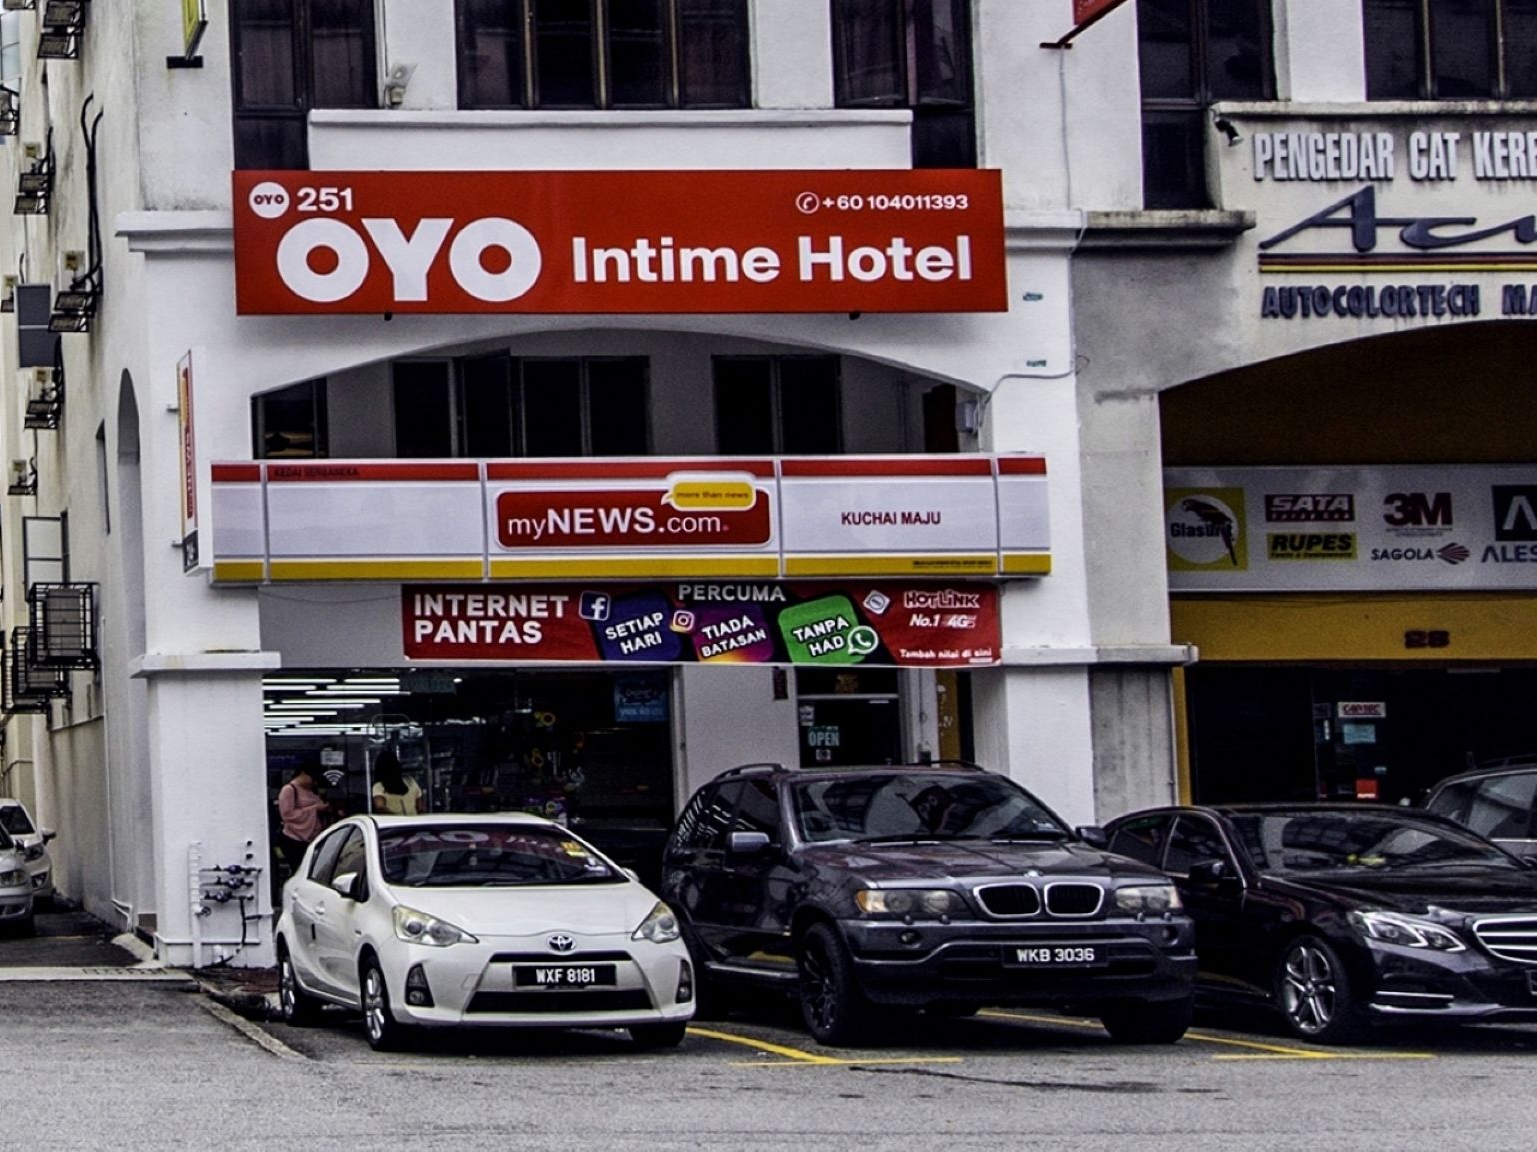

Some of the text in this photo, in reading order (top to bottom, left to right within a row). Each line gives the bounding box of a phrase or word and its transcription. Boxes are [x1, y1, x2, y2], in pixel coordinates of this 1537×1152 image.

[1254, 132, 1394, 182] PENGEDAR
[1408, 130, 1461, 181] CAT
[253, 193, 285, 206] OYO
[296, 186, 354, 212] 251
[822, 194, 969, 211] +60 104011393
[276, 216, 543, 303] OYO
[572, 234, 972, 283] Intime Hotel
[1262, 284, 1480, 319] AUTOCOLORTECH
[702, 490, 723, 499] than
[1271, 496, 1351, 512] SATA
[841, 511, 942, 526] KUCHAI MAJU
[1383, 493, 1453, 526] 3M
[508, 506, 722, 540] myNEWS.com
[1271, 534, 1353, 551] RUPES
[1371, 548, 1434, 561] SAGOLA
[678, 584, 787, 602] PERCUMA
[414, 594, 569, 618] INTERNET
[605, 612, 664, 641] SETIAP
[701, 614, 755, 641] TIADA
[792, 615, 850, 643] TANPA
[909, 613, 941, 627] No.1
[414, 620, 543, 644] PANTAS
[619, 631, 662, 655] HARI
[701, 628, 767, 658] BATASAN
[809, 635, 846, 657] HAD
[899, 648, 993, 659] Tambah nilai di sini
[808, 731, 840, 747] OPEN
[1016, 947, 1095, 964] WKB 3036
[536, 967, 596, 984] WXF 8181
